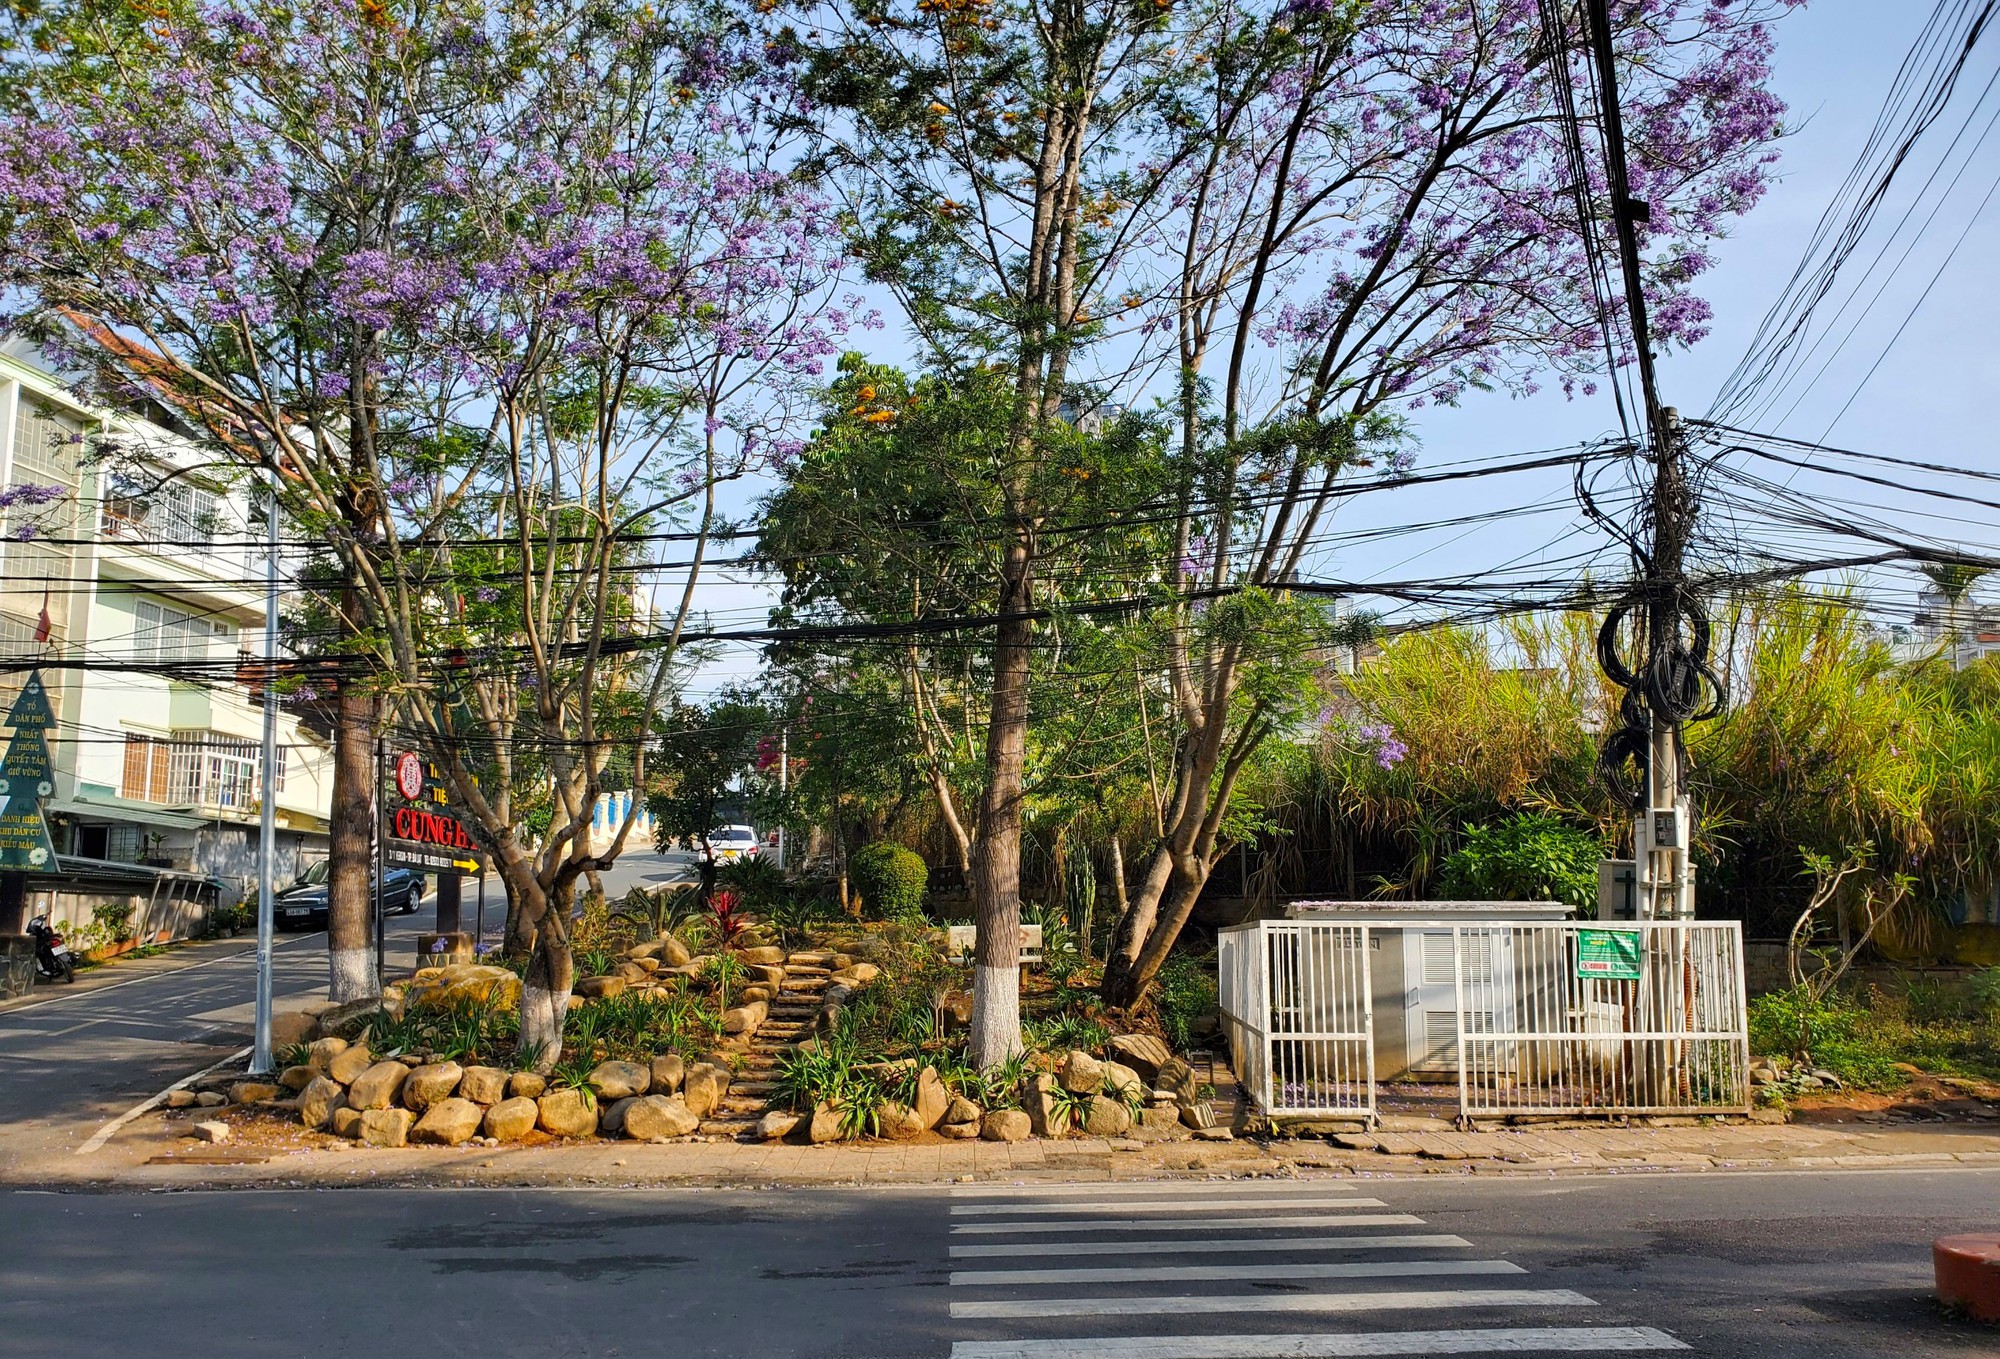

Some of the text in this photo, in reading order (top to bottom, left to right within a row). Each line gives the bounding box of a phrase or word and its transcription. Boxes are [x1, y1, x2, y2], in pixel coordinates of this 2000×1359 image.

[15, 713, 46, 723] DÂN PHỐ
[19, 728, 39, 739] NHẤT
[16, 741, 40, 752] THỐNG
[6, 753, 47, 766] QUYẾT TÂM
[1, 814, 41, 826] DANH HIỆU
[13, 826, 29, 836] DÂN
[396, 807, 453, 846] CUNG
